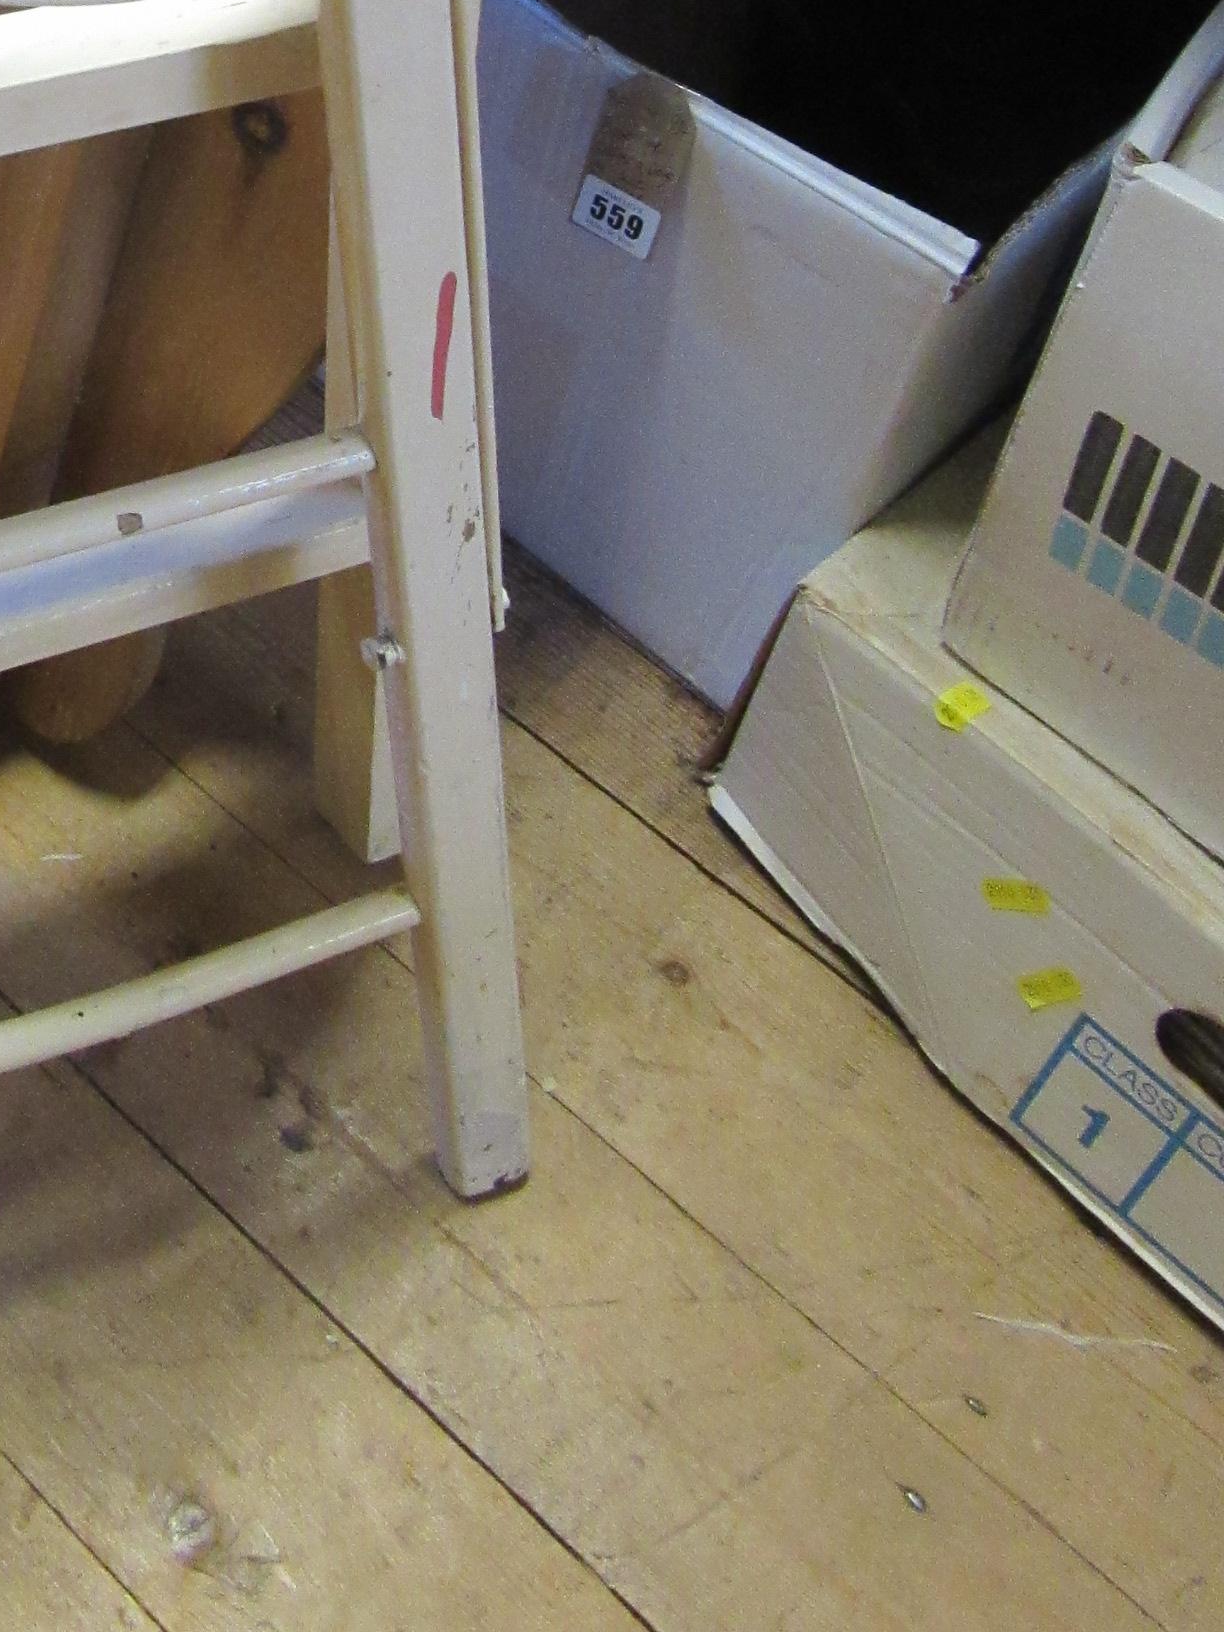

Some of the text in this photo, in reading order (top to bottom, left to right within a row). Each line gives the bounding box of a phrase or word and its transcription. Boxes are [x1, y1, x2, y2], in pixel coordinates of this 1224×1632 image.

[590, 193, 644, 241] 559
[1084, 1035, 1178, 1122] CLASS
[1078, 1104, 1111, 1150] 1
